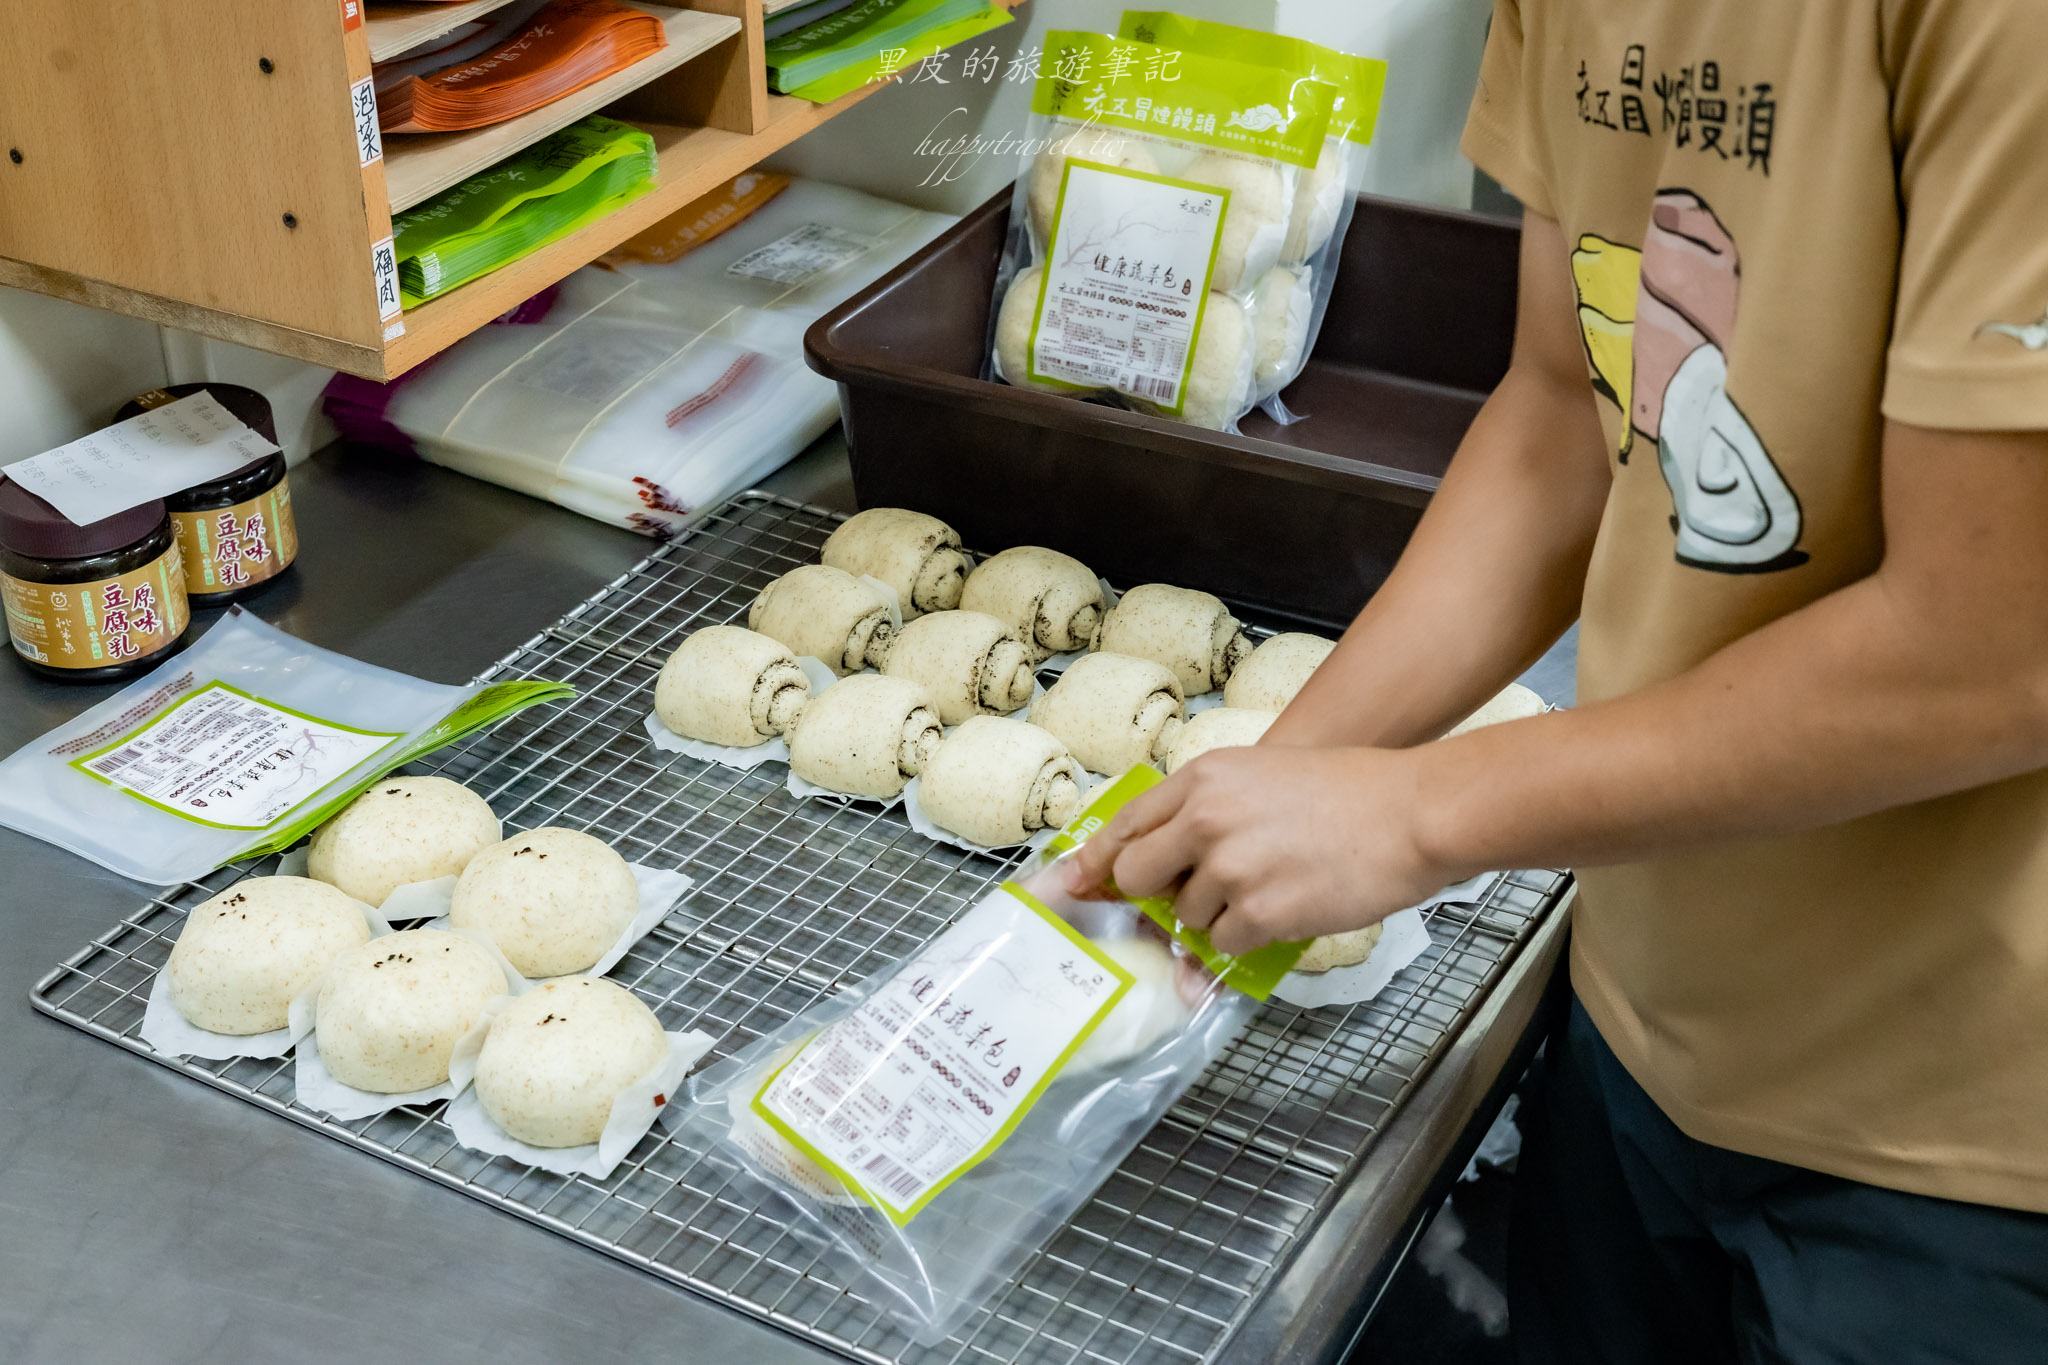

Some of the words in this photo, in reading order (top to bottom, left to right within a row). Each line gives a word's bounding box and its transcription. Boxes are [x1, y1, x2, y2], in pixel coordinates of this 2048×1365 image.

[353, 84, 379, 160] 泡菜
[1082, 83, 1216, 136] 老五冒煙饅頭
[374, 247, 394, 310] 福肉
[1093, 252, 1177, 289] 健康蔬菜包
[215, 512, 249, 586] 豆腐乳
[244, 513, 271, 563] 原味
[102, 583, 139, 658] 豆腐乳
[132, 583, 161, 634] 原味
[208, 747, 295, 799] 健康蔬菜包
